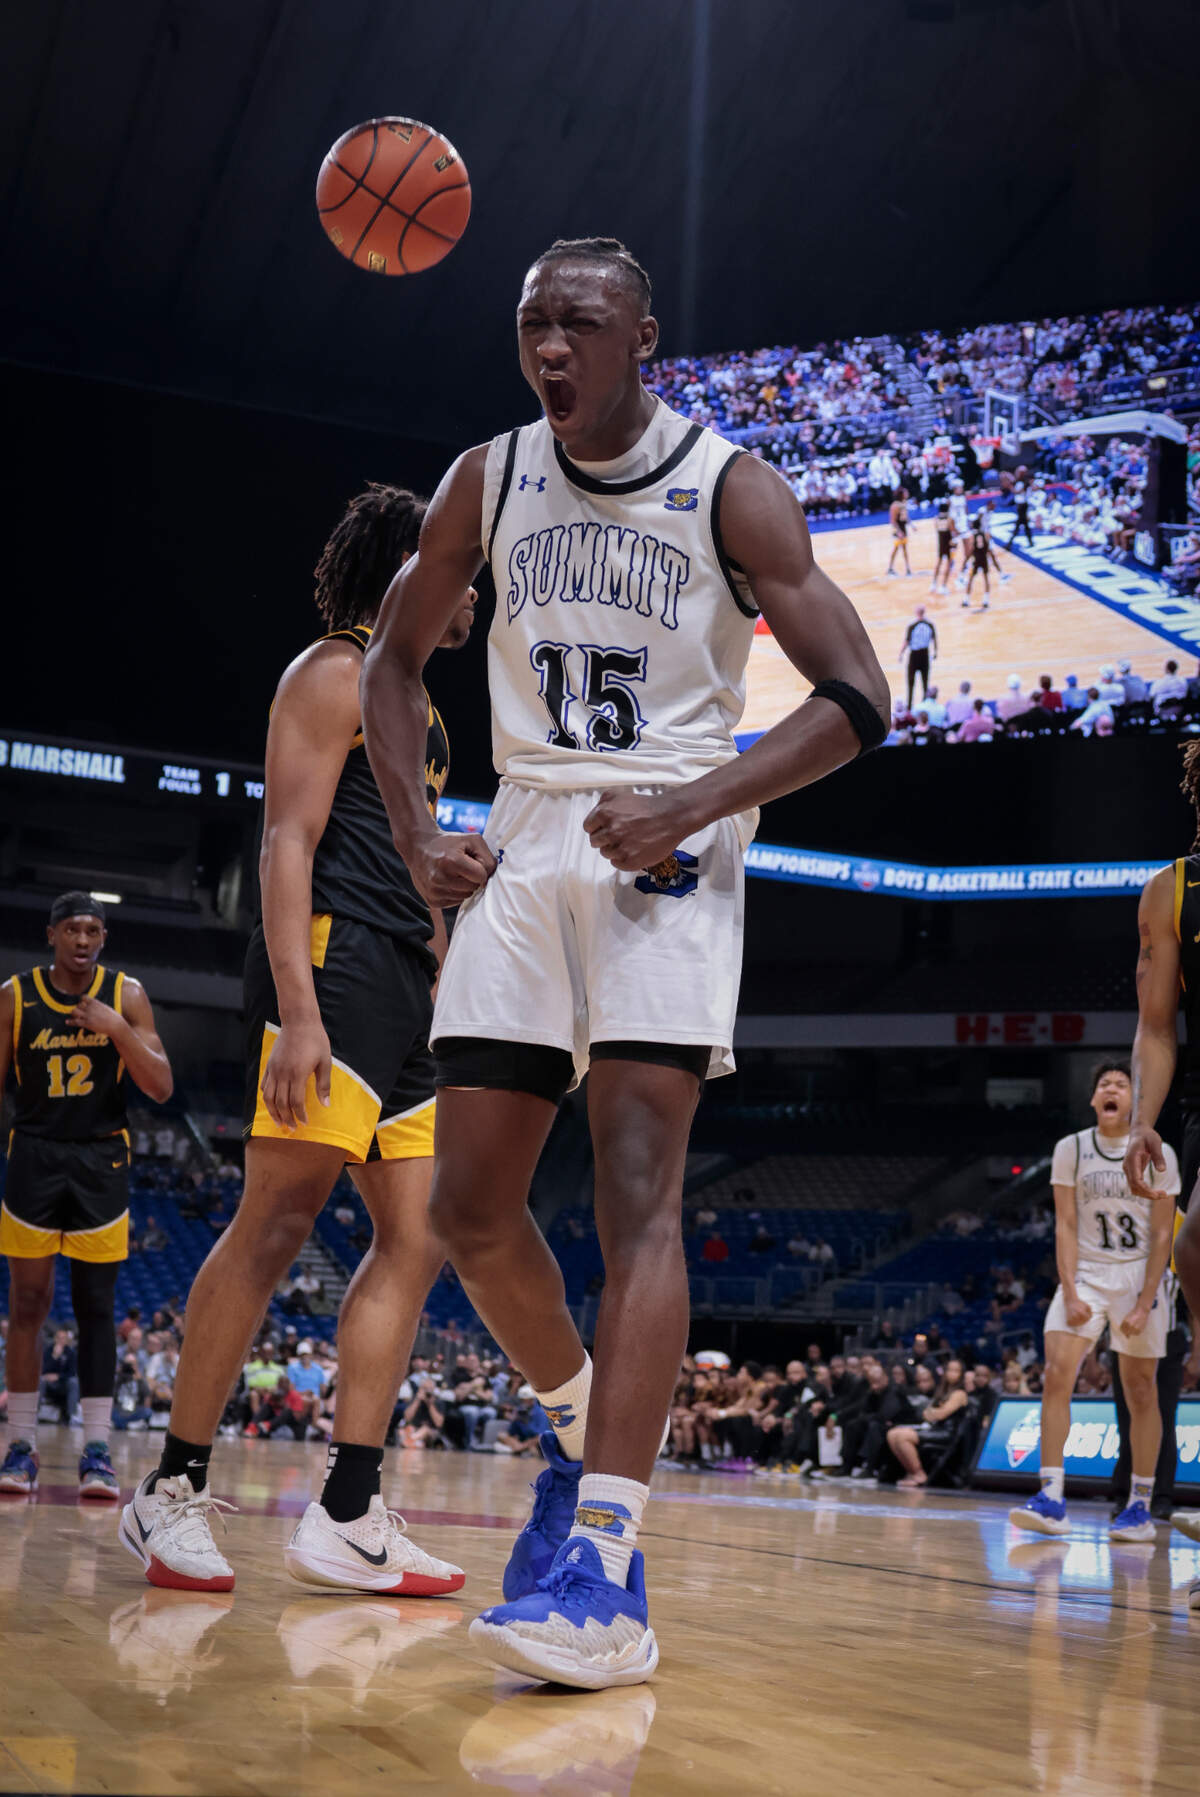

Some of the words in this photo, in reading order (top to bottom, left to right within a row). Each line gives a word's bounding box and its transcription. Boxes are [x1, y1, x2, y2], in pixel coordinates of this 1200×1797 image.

[507, 521, 691, 631] SUMMIT
[529, 640, 649, 752] 15
[10, 741, 125, 783] MARSHALL
[163, 765, 200, 781] TEAM
[158, 776, 202, 795] FOULS
[215, 771, 231, 797] 1
[883, 867, 925, 891] BOYS
[926, 871, 1026, 892] BASKETBALL
[1027, 870, 1072, 889] STATE
[47, 1054, 95, 1098] 12
[1095, 1210, 1140, 1252] 13
